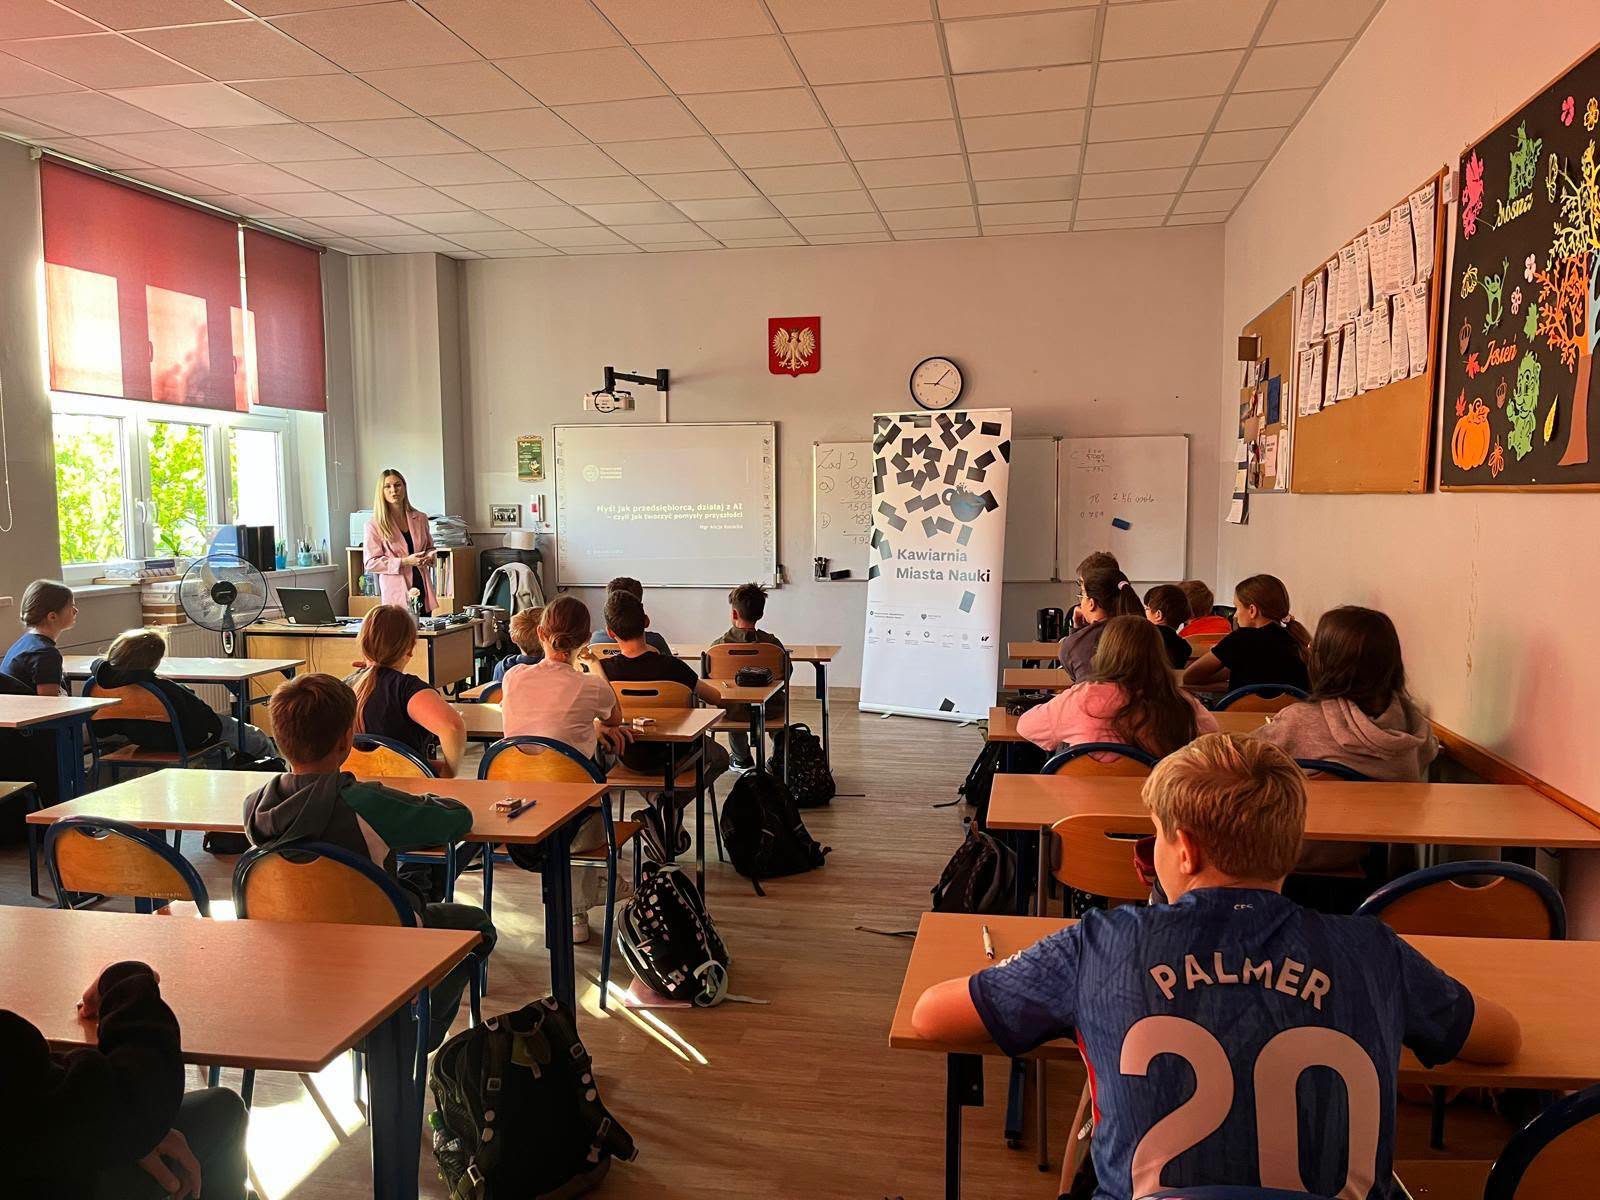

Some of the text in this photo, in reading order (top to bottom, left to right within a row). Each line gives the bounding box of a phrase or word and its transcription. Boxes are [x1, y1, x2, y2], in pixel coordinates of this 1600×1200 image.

[1480, 333, 1517, 373] Jesień
[847, 450, 858, 470] 3
[617, 503, 631, 513] jak
[632, 503, 695, 513] przedsiębiorca,
[631, 513, 643, 521] jak
[897, 548, 967, 562] Kawiarnia
[896, 566, 991, 583] Miasta Nauki
[1149, 951, 1332, 1011] PALMER
[1119, 1015, 1381, 1199] 20
